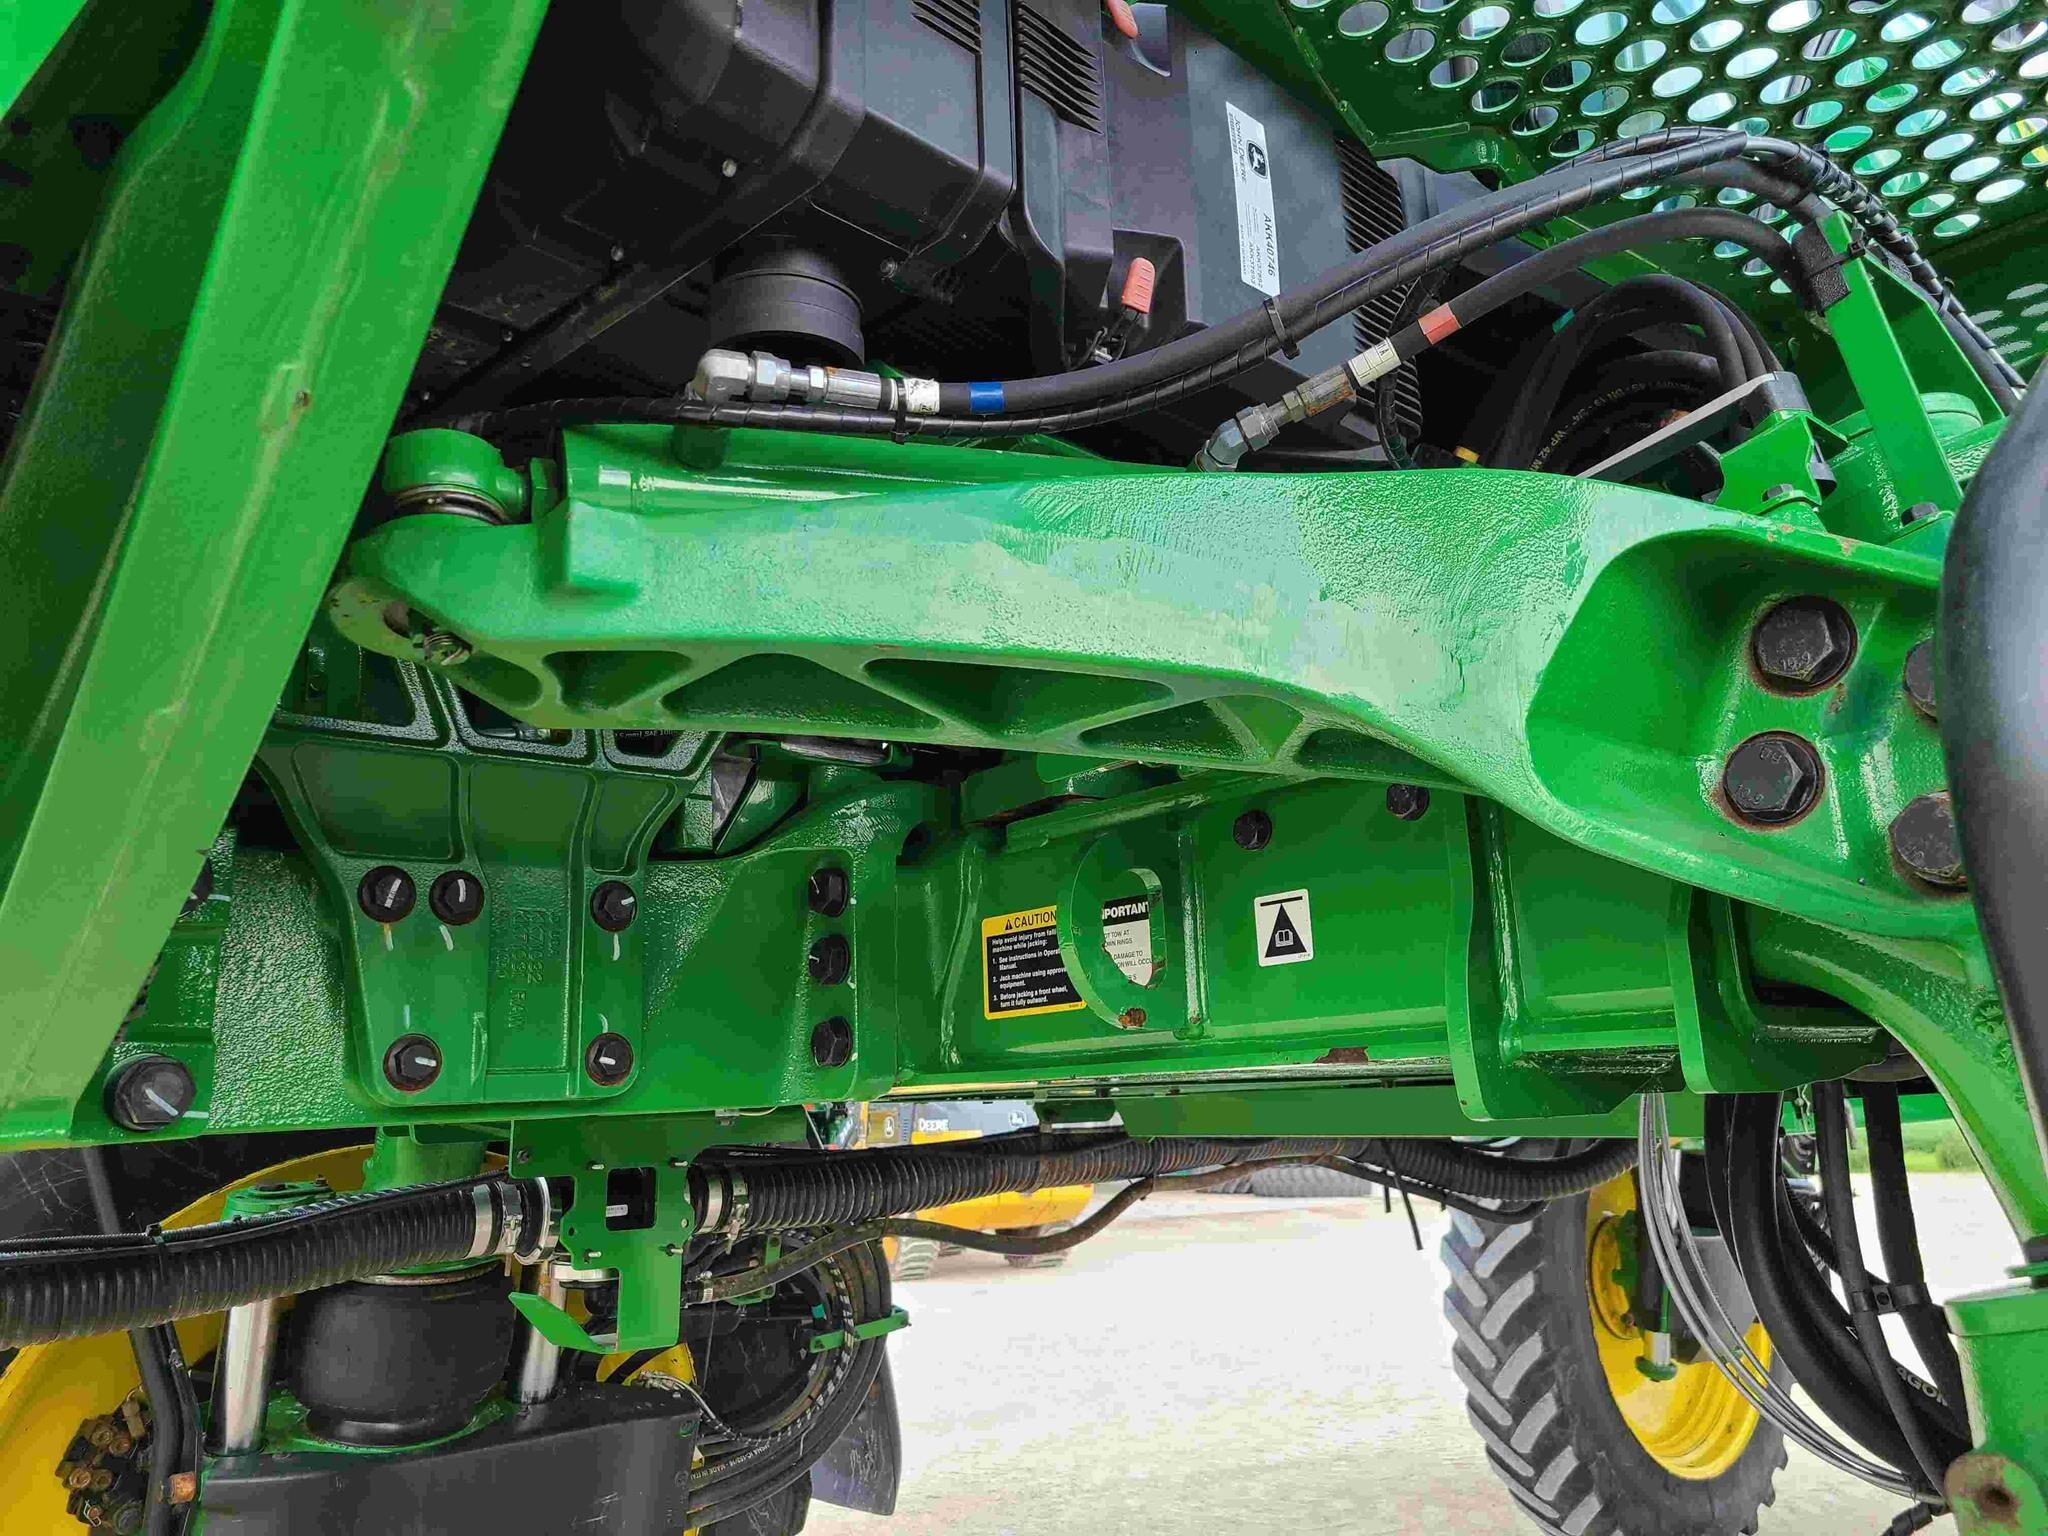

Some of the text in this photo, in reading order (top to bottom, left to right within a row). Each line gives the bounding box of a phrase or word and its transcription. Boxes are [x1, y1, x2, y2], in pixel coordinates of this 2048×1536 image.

[1233, 115, 1244, 147] JOHN
[1237, 147, 1247, 184] DEERE
[1263, 214, 1276, 276] AKK40746
[1014, 911, 1056, 929] CAUTION
[1034, 930, 1046, 938] from
[992, 944, 1012, 953] machine
[1013, 942, 1027, 950] while
[998, 956, 1008, 964] See
[999, 974, 1011, 982] Jack
[1011, 971, 1032, 980] machine
[1032, 968, 1046, 977] using
[1000, 992, 1016, 1001] Before
[1016, 990, 1034, 999] jacking
[1038, 987, 1051, 995] front
[1015, 999, 1026, 1007] fully
